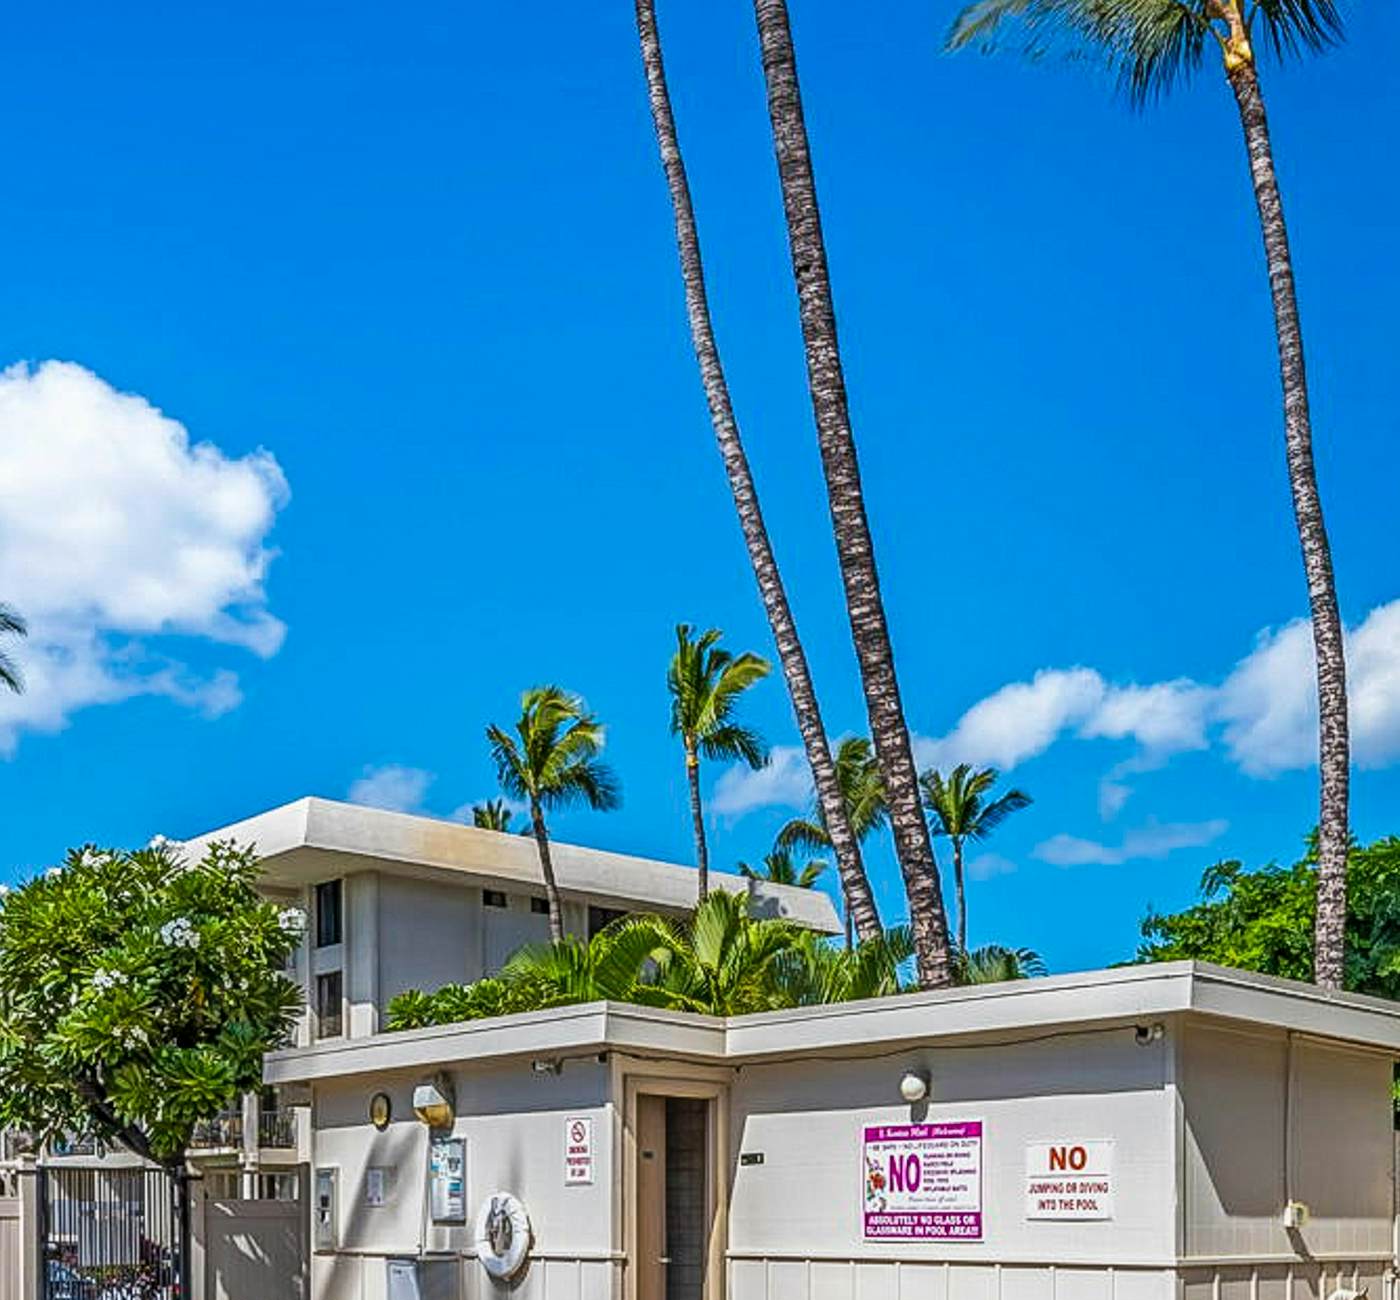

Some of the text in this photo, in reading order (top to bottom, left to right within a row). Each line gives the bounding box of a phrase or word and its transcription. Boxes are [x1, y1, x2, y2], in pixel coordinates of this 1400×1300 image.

[1049, 1146, 1087, 1171] NO
[889, 1153, 921, 1193] NO
[1029, 1182, 1108, 1194] JUMPING OR DIVING
[1038, 1199, 1098, 1211] INTO THE POOL
[868, 1215, 976, 1225] ABSOLUTELY NO GLASS OR
[867, 1226, 913, 1236] GLASSWARE
[914, 1226, 924, 1236] IN
[925, 1226, 947, 1236] POOL
